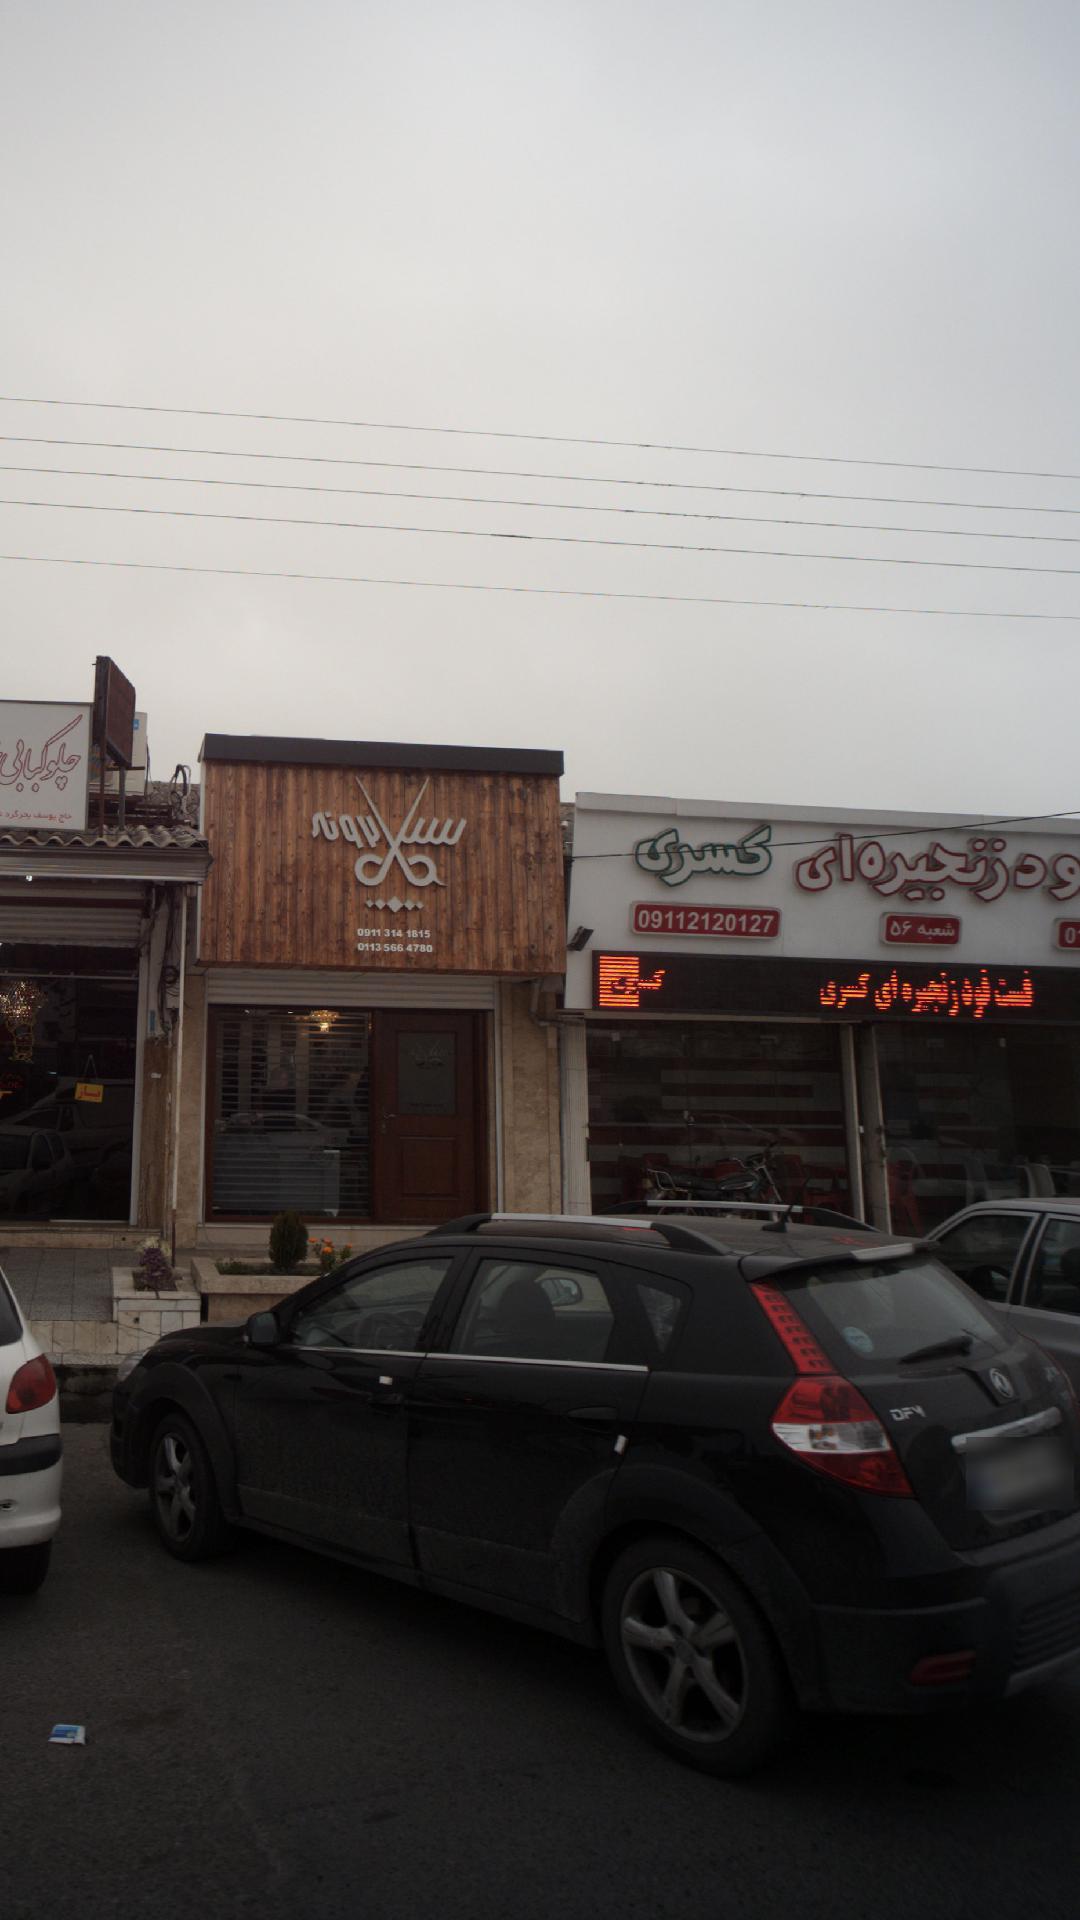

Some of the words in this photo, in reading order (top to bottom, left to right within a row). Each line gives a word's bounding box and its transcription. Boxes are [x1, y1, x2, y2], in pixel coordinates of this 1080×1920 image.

[634, 824, 773, 887] کسری
[637, 909, 775, 933] 09112120127
[917, 921, 956, 940] شعبه
[357, 928, 381, 937] 0911
[384, 928, 403, 938] 314
[357, 942, 382, 952] 0113
[384, 943, 404, 952] 566
[406, 943, 433, 953] 4780
